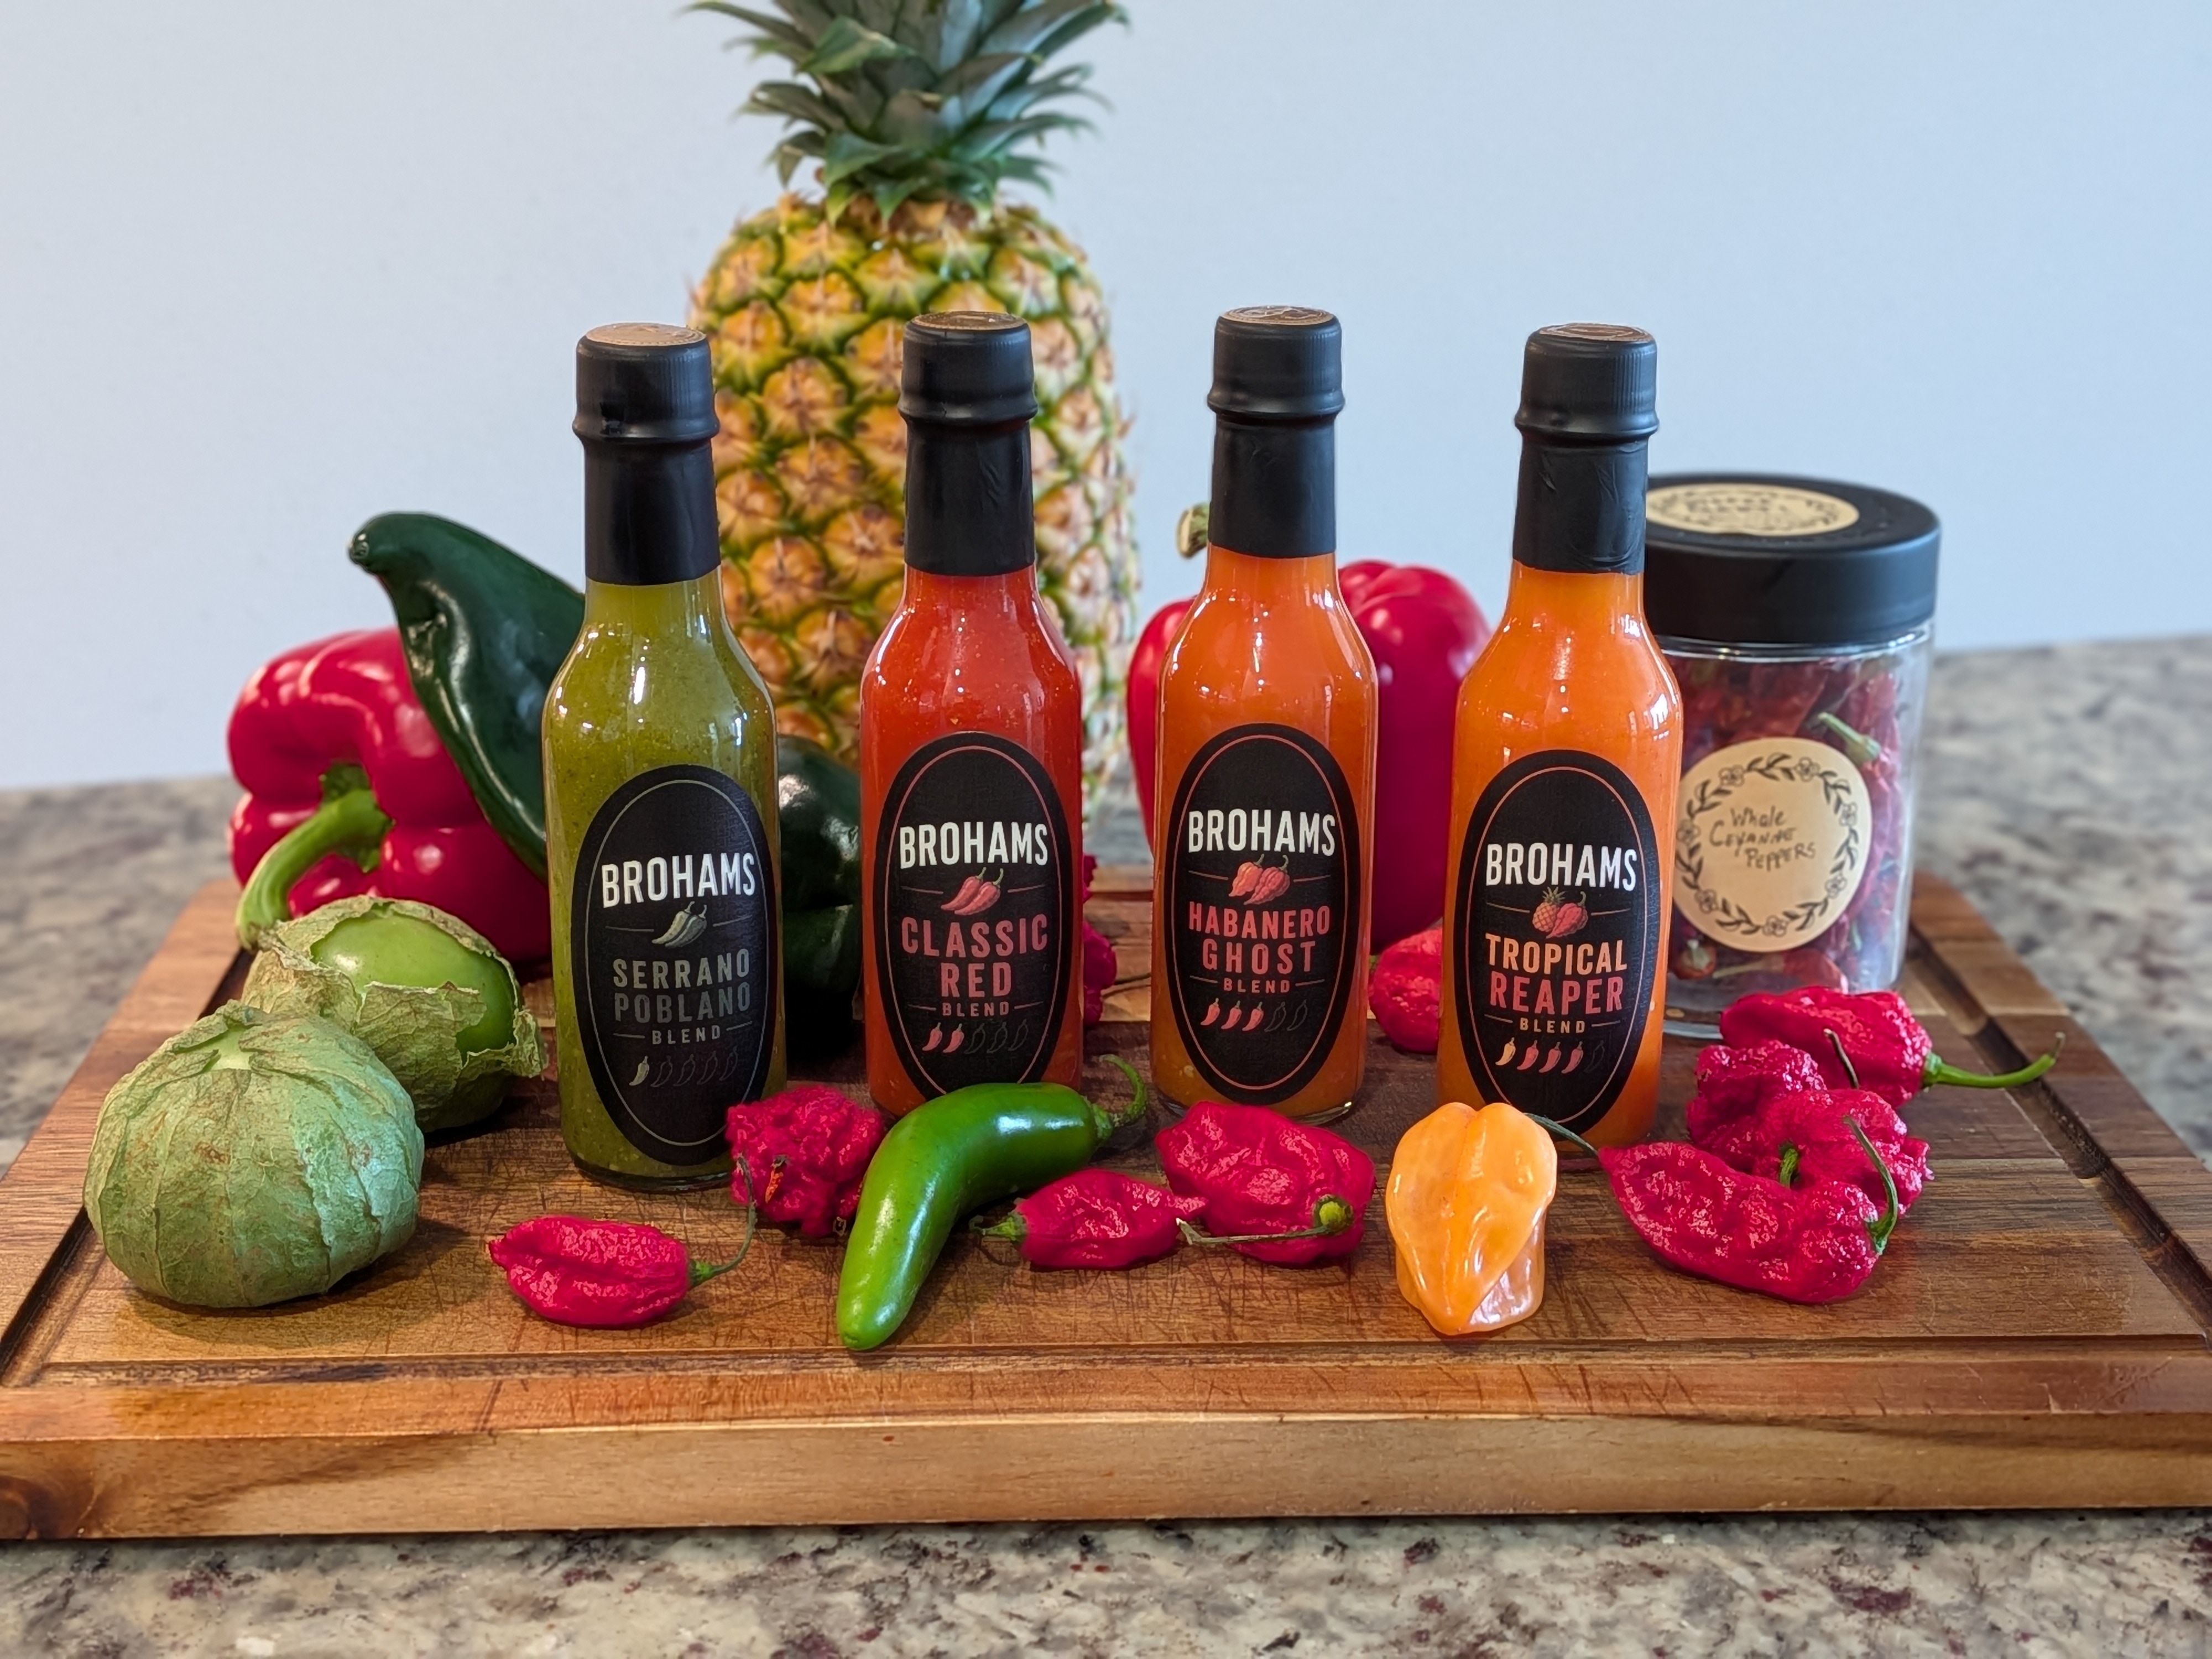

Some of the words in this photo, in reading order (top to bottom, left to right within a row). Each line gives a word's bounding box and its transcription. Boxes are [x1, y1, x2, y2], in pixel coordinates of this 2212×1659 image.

[1188, 808, 1335, 856] BROHAMS
[1730, 806, 1785, 827] Whole
[900, 822, 1048, 869] BROHAMS
[602, 852, 755, 907] BROHAMS
[1486, 843, 1637, 891] BROHAMS
[901, 914, 1048, 958] CLASSIC
[1188, 901, 1331, 939] HABANERO
[613, 948, 749, 989] SERRANO
[1202, 938, 1316, 974] GHOST
[1485, 933, 1627, 975] TROPICAL
[941, 962, 1012, 998] RED
[1224, 977, 1290, 993] BLEND
[1490, 971, 1623, 1015] REAPER
[614, 982, 750, 1023] POBLANO
[943, 1001, 1010, 1017] BLEND
[653, 1025, 720, 1045] BLEND
[1520, 1018, 1585, 1034] BLEND
